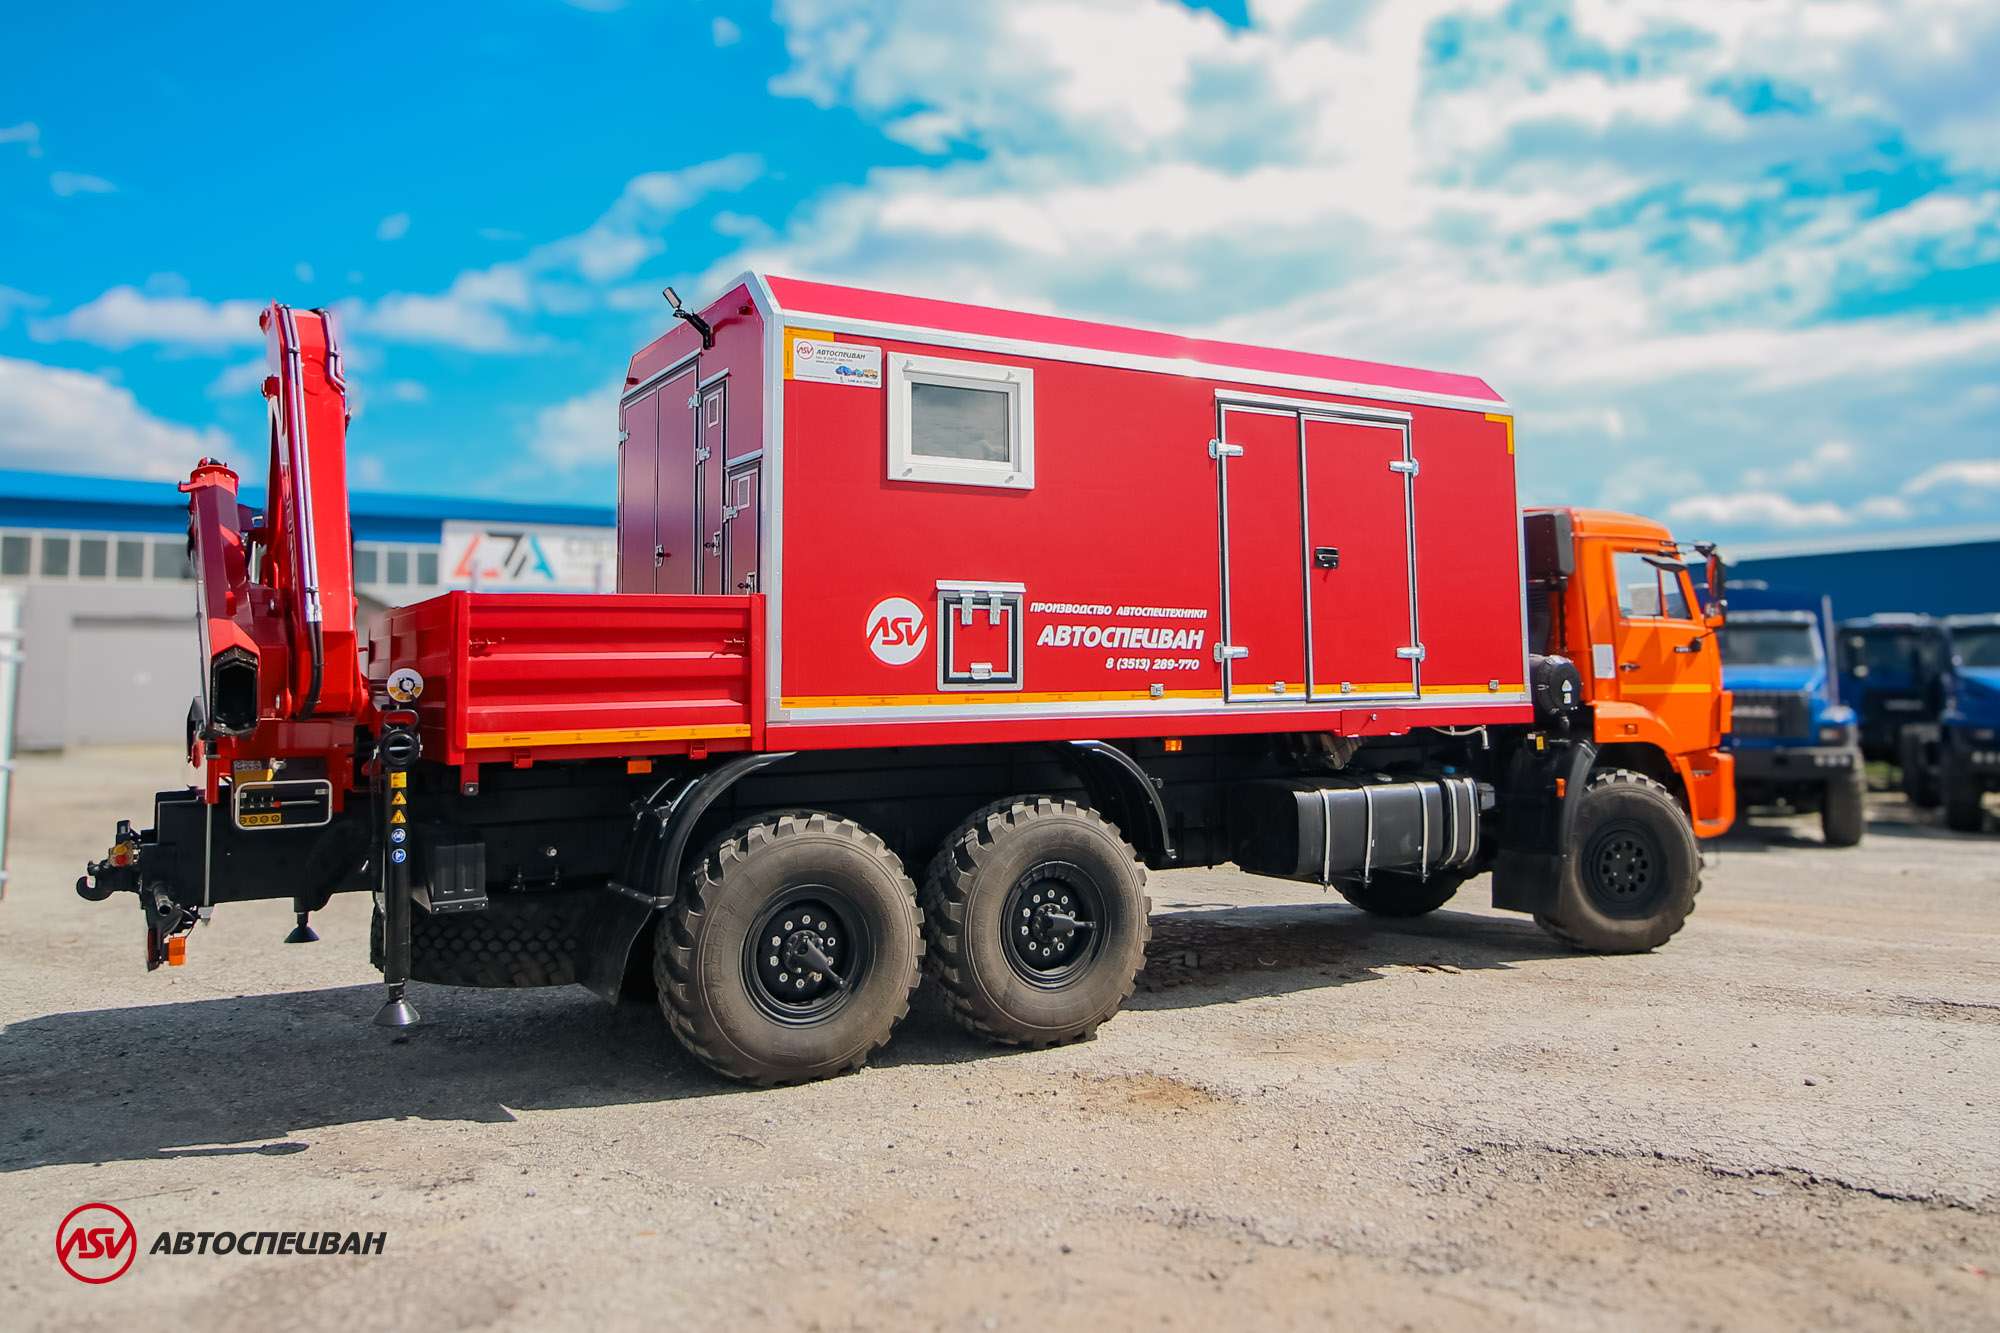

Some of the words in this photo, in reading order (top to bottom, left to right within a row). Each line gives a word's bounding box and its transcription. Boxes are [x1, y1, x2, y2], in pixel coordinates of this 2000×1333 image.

[1029, 602, 1113, 616] ПРОИЗВОДСТВО
[1115, 605, 1208, 619] АВТОСПЕЦТЕХНИКИ
[1036, 624, 1205, 650] АВТОСПЕЦВАН
[1105, 657, 1115, 669] 8
[1116, 657, 1151, 672] (3513)
[1152, 658, 1200, 670] 289-770
